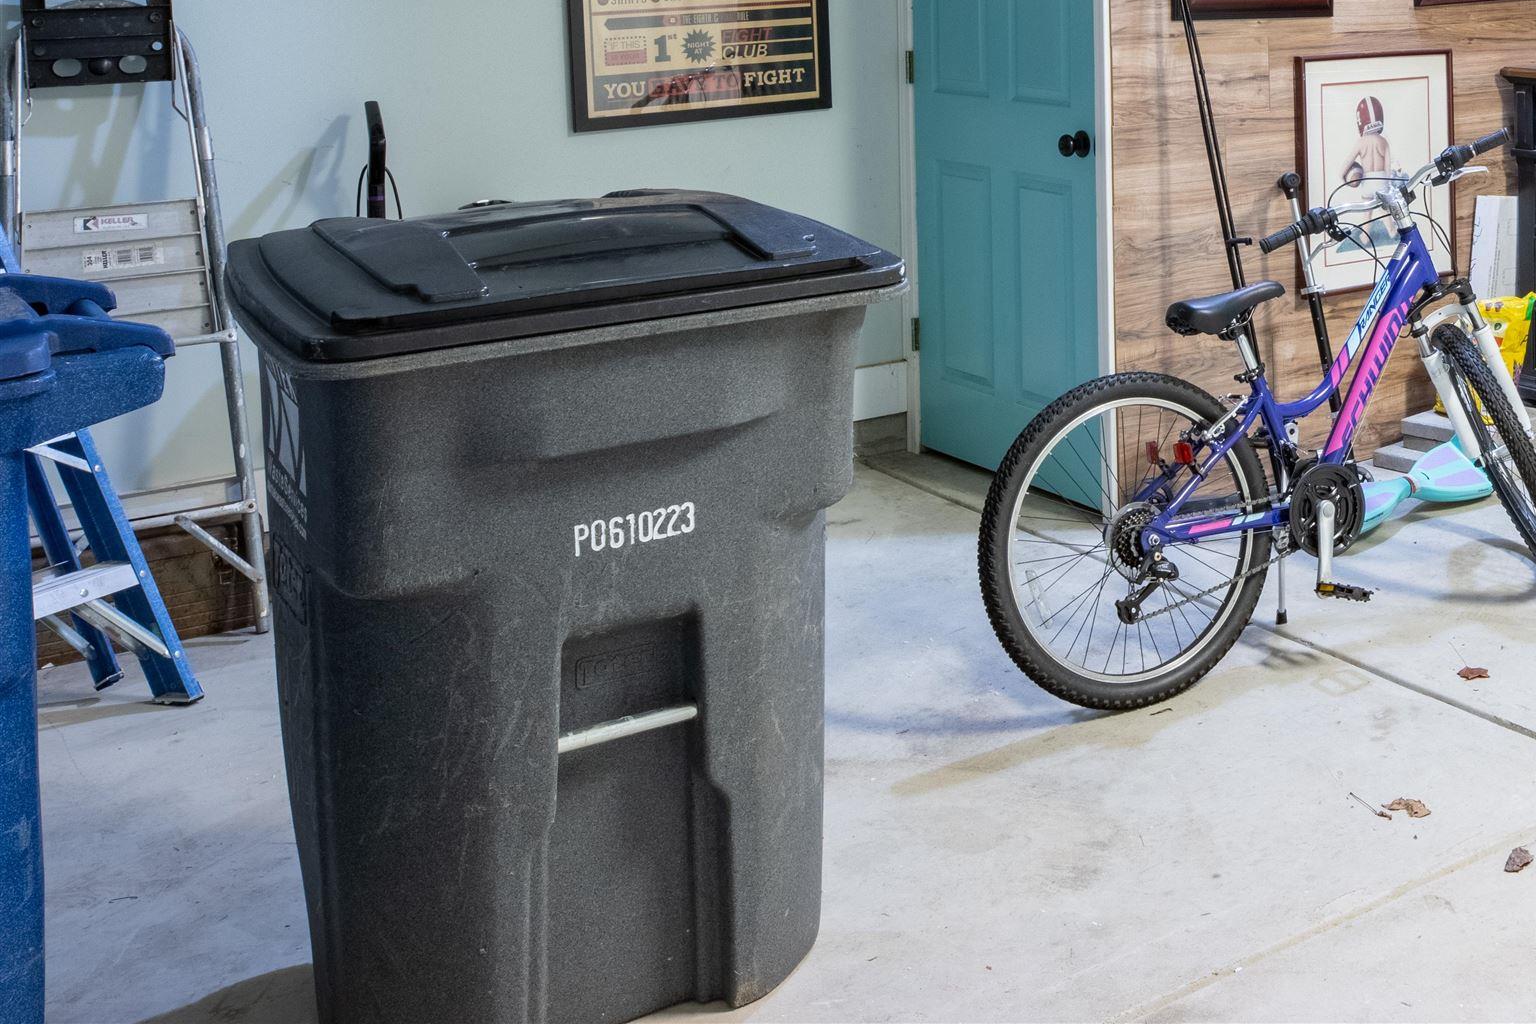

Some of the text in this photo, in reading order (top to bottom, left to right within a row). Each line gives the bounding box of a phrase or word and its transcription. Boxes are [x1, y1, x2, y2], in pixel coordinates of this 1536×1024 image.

[722, 28, 773, 43] FIGHT
[621, 40, 641, 48] THIS
[723, 44, 768, 59] CLUB
[603, 81, 645, 99] YOU
[743, 67, 805, 87] FIGHT
[101, 217, 134, 225] KELLER
